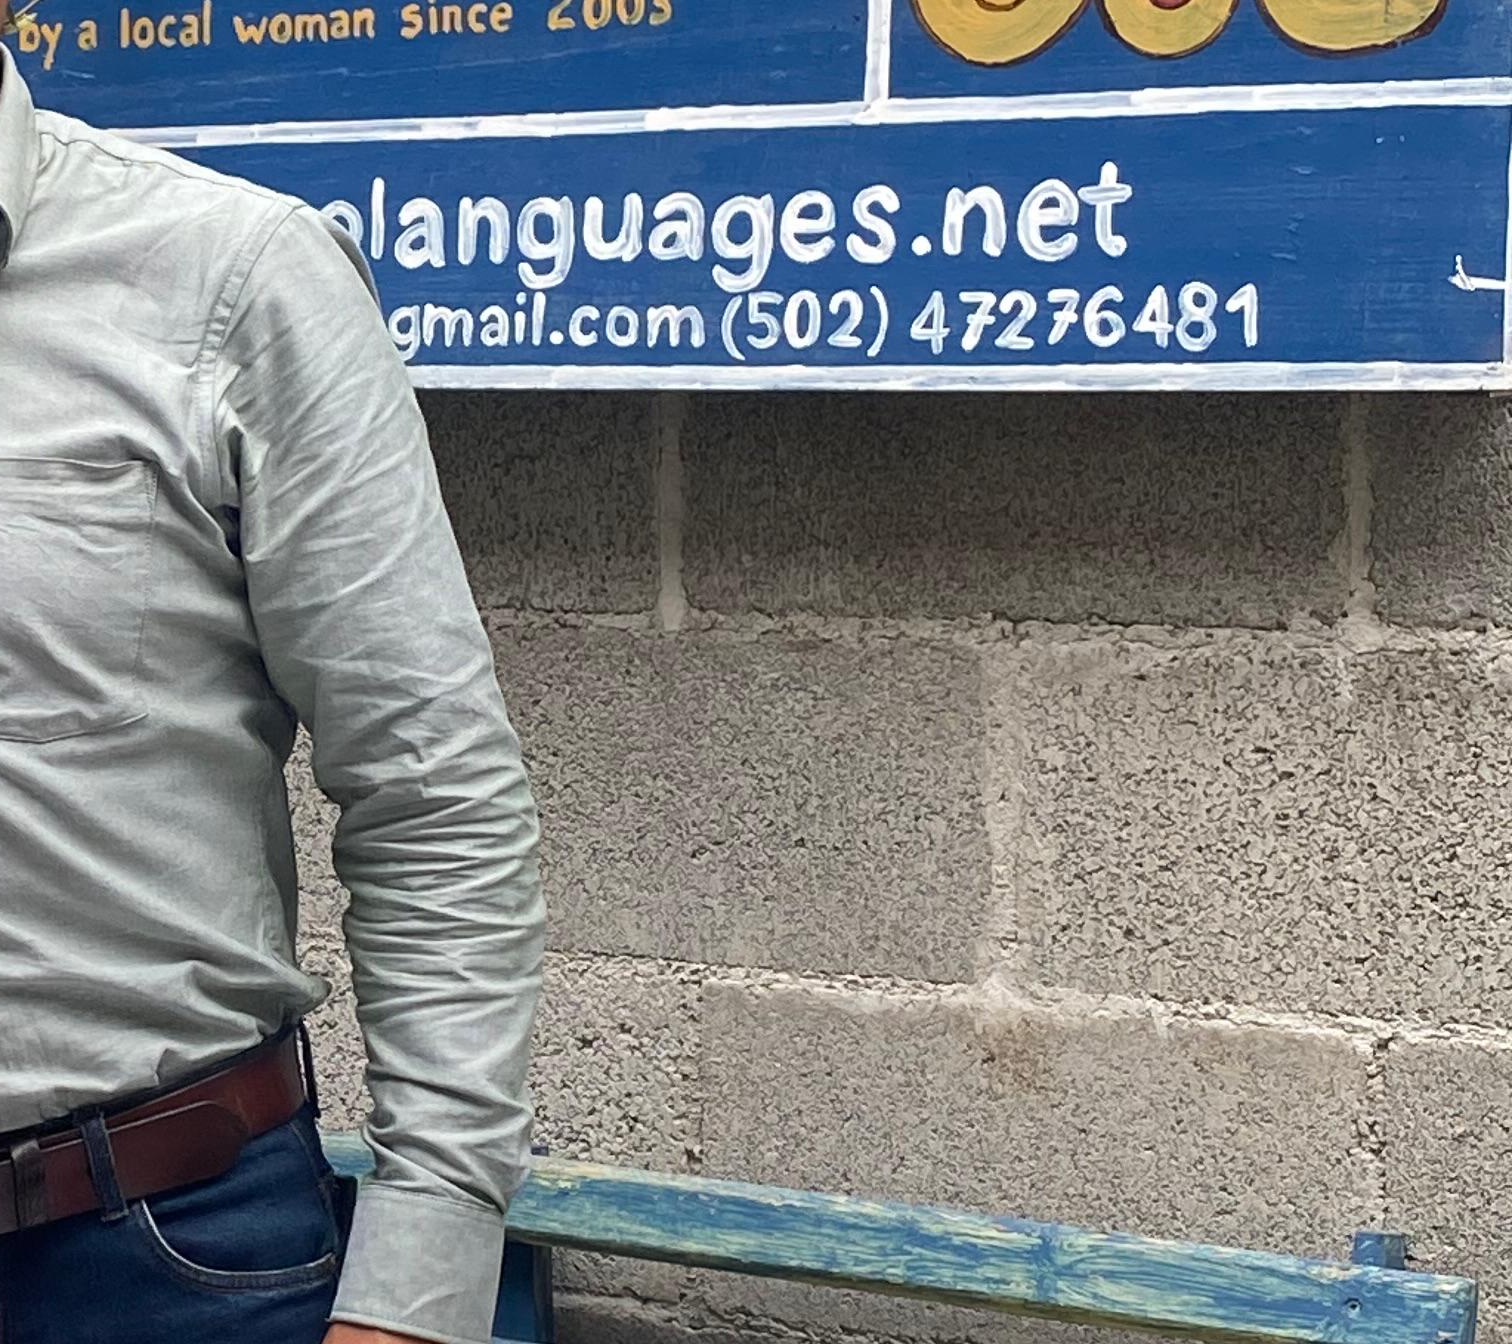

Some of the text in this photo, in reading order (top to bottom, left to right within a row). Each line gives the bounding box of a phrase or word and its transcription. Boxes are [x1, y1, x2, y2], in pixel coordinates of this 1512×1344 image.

[18, 20, 63, 71] by
[76, 18, 98, 49] a
[233, 5, 376, 46] woman
[320, 160, 1134, 291] olanguages.net
[388, 281, 1259, 362] gmail.com (502) 47276481
